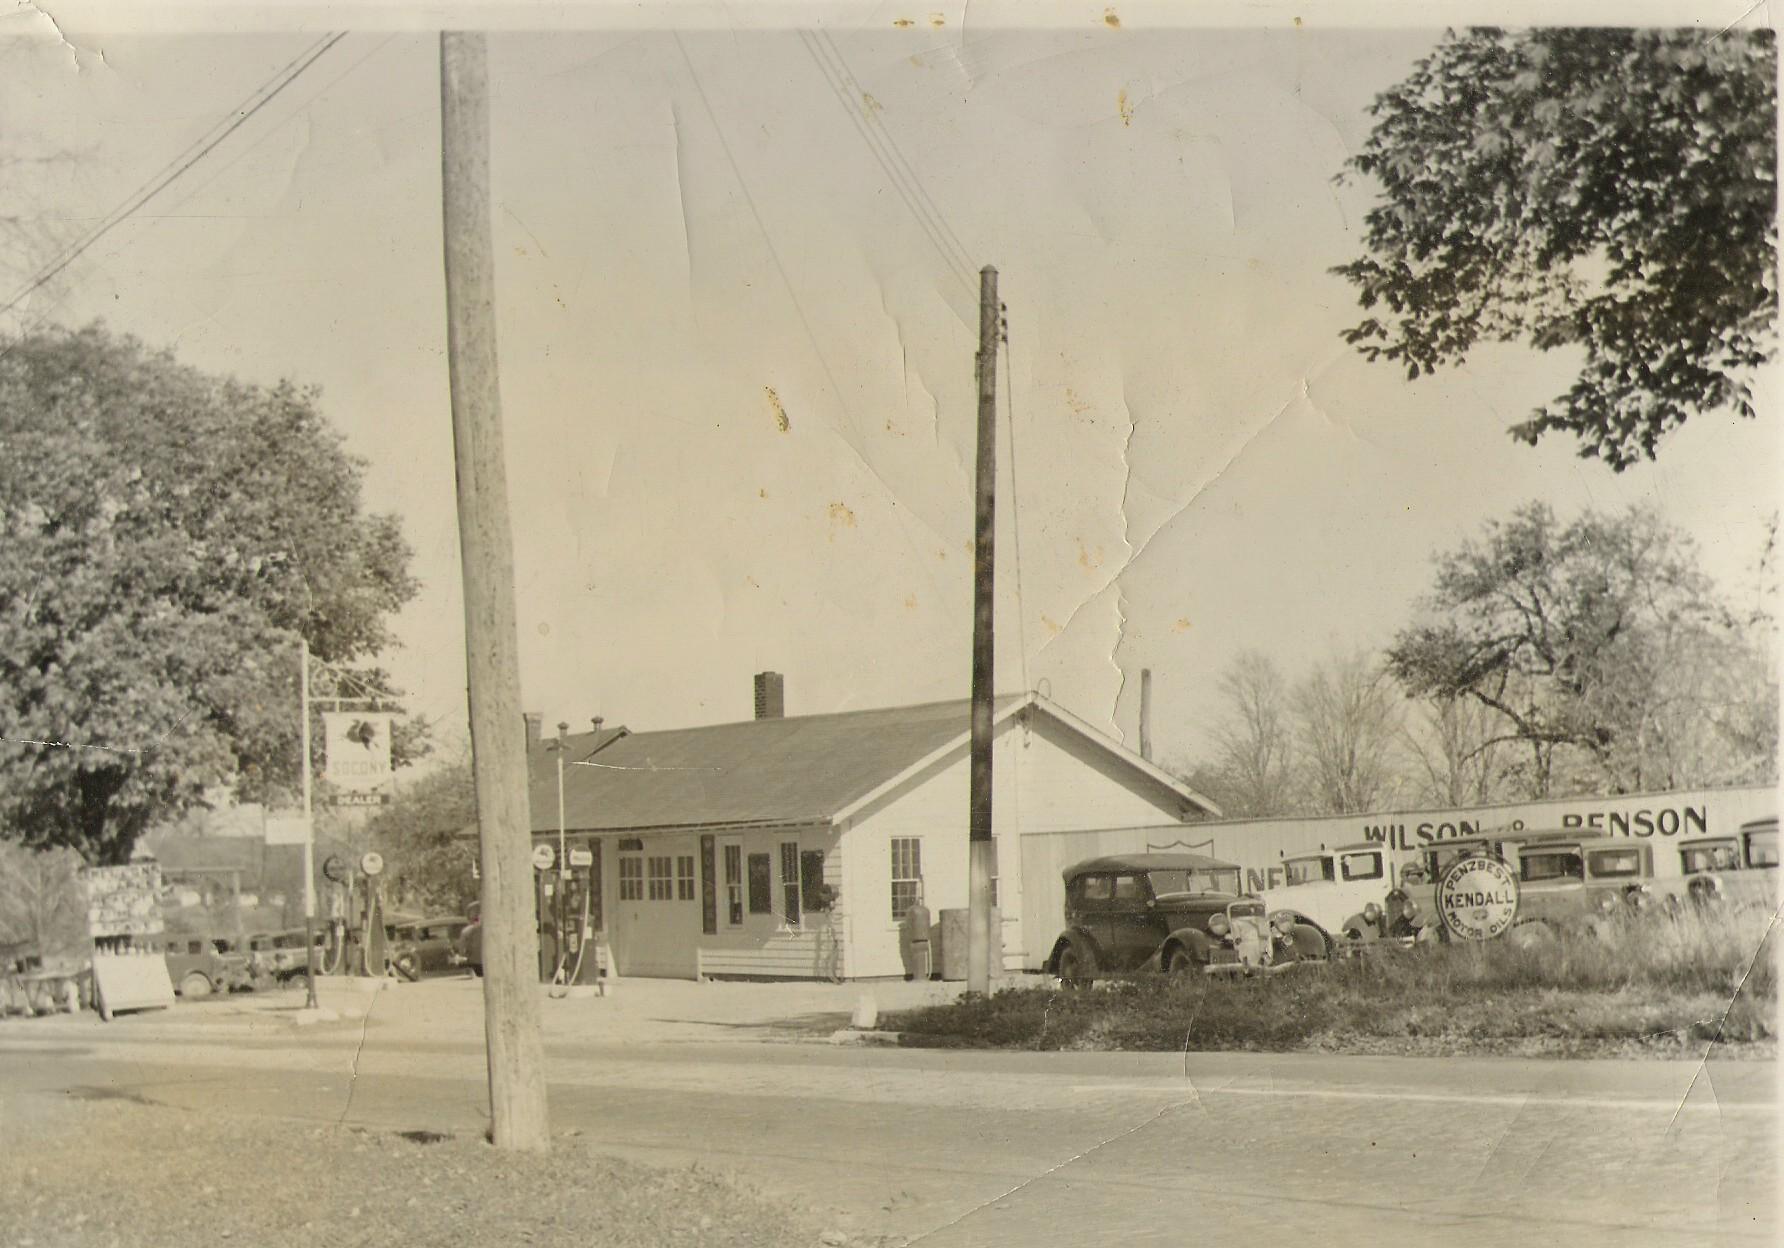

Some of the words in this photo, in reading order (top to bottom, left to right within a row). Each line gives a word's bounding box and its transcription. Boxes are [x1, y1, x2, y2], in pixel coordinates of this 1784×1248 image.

[333, 760, 386, 775] SOCONY
[337, 795, 381, 805] DEALER
[1446, 860, 1511, 891] PENZBEST
[1444, 890, 1514, 909] KENDALL
[1448, 911, 1483, 938] MOTOR
[1489, 908, 1512, 933] OILS
